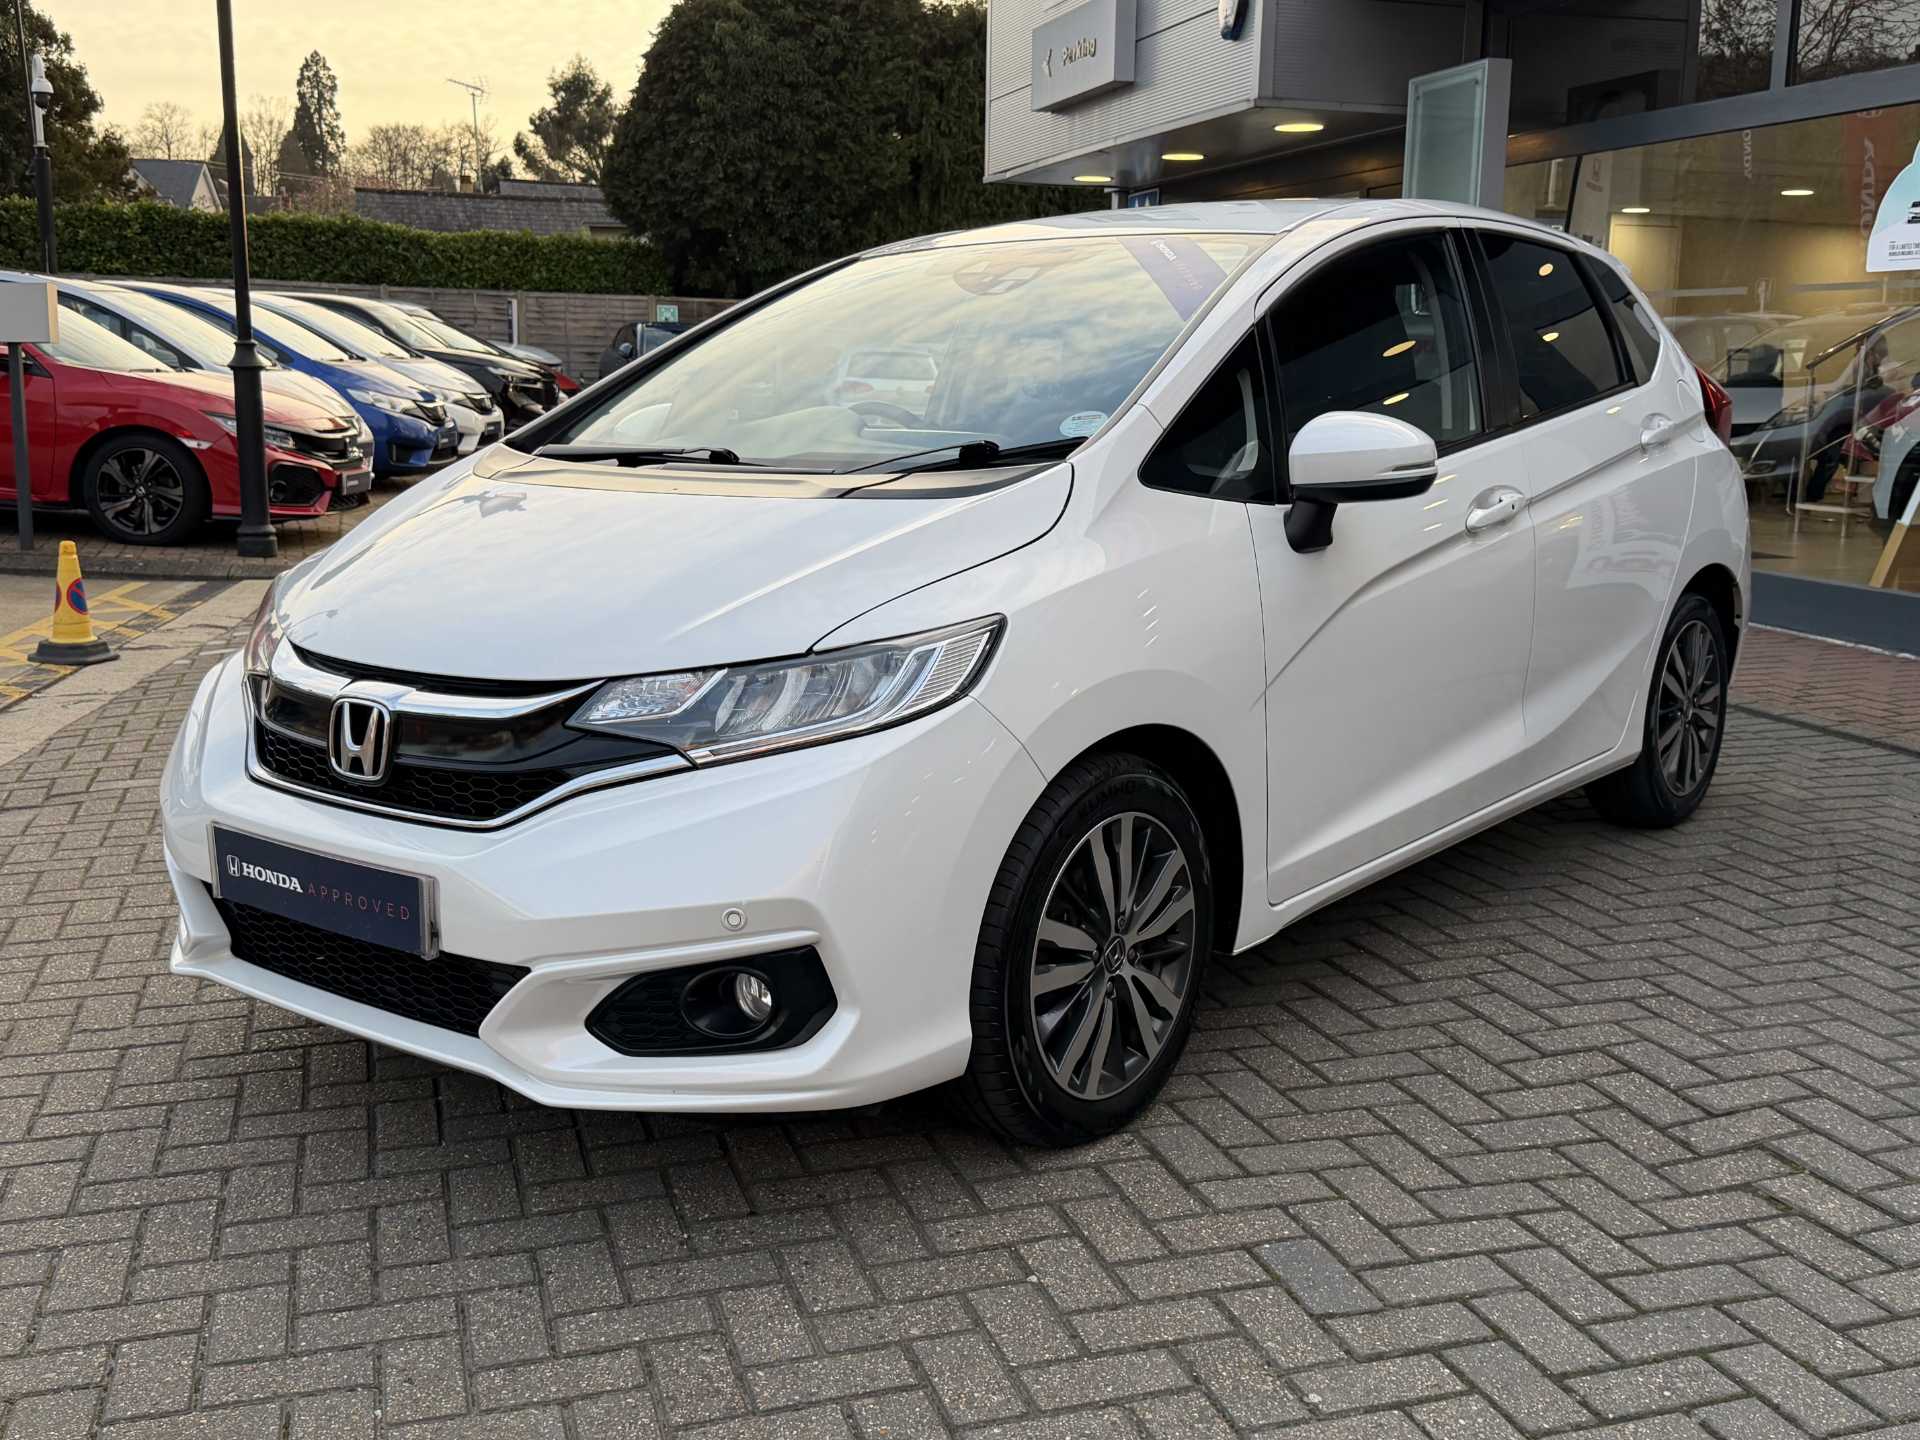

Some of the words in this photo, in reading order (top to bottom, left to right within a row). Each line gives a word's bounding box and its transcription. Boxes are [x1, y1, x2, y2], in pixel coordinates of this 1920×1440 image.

[1062, 37, 1097, 67] Parking
[241, 861, 304, 893] HONDA
[307, 882, 410, 921] APPROVED
